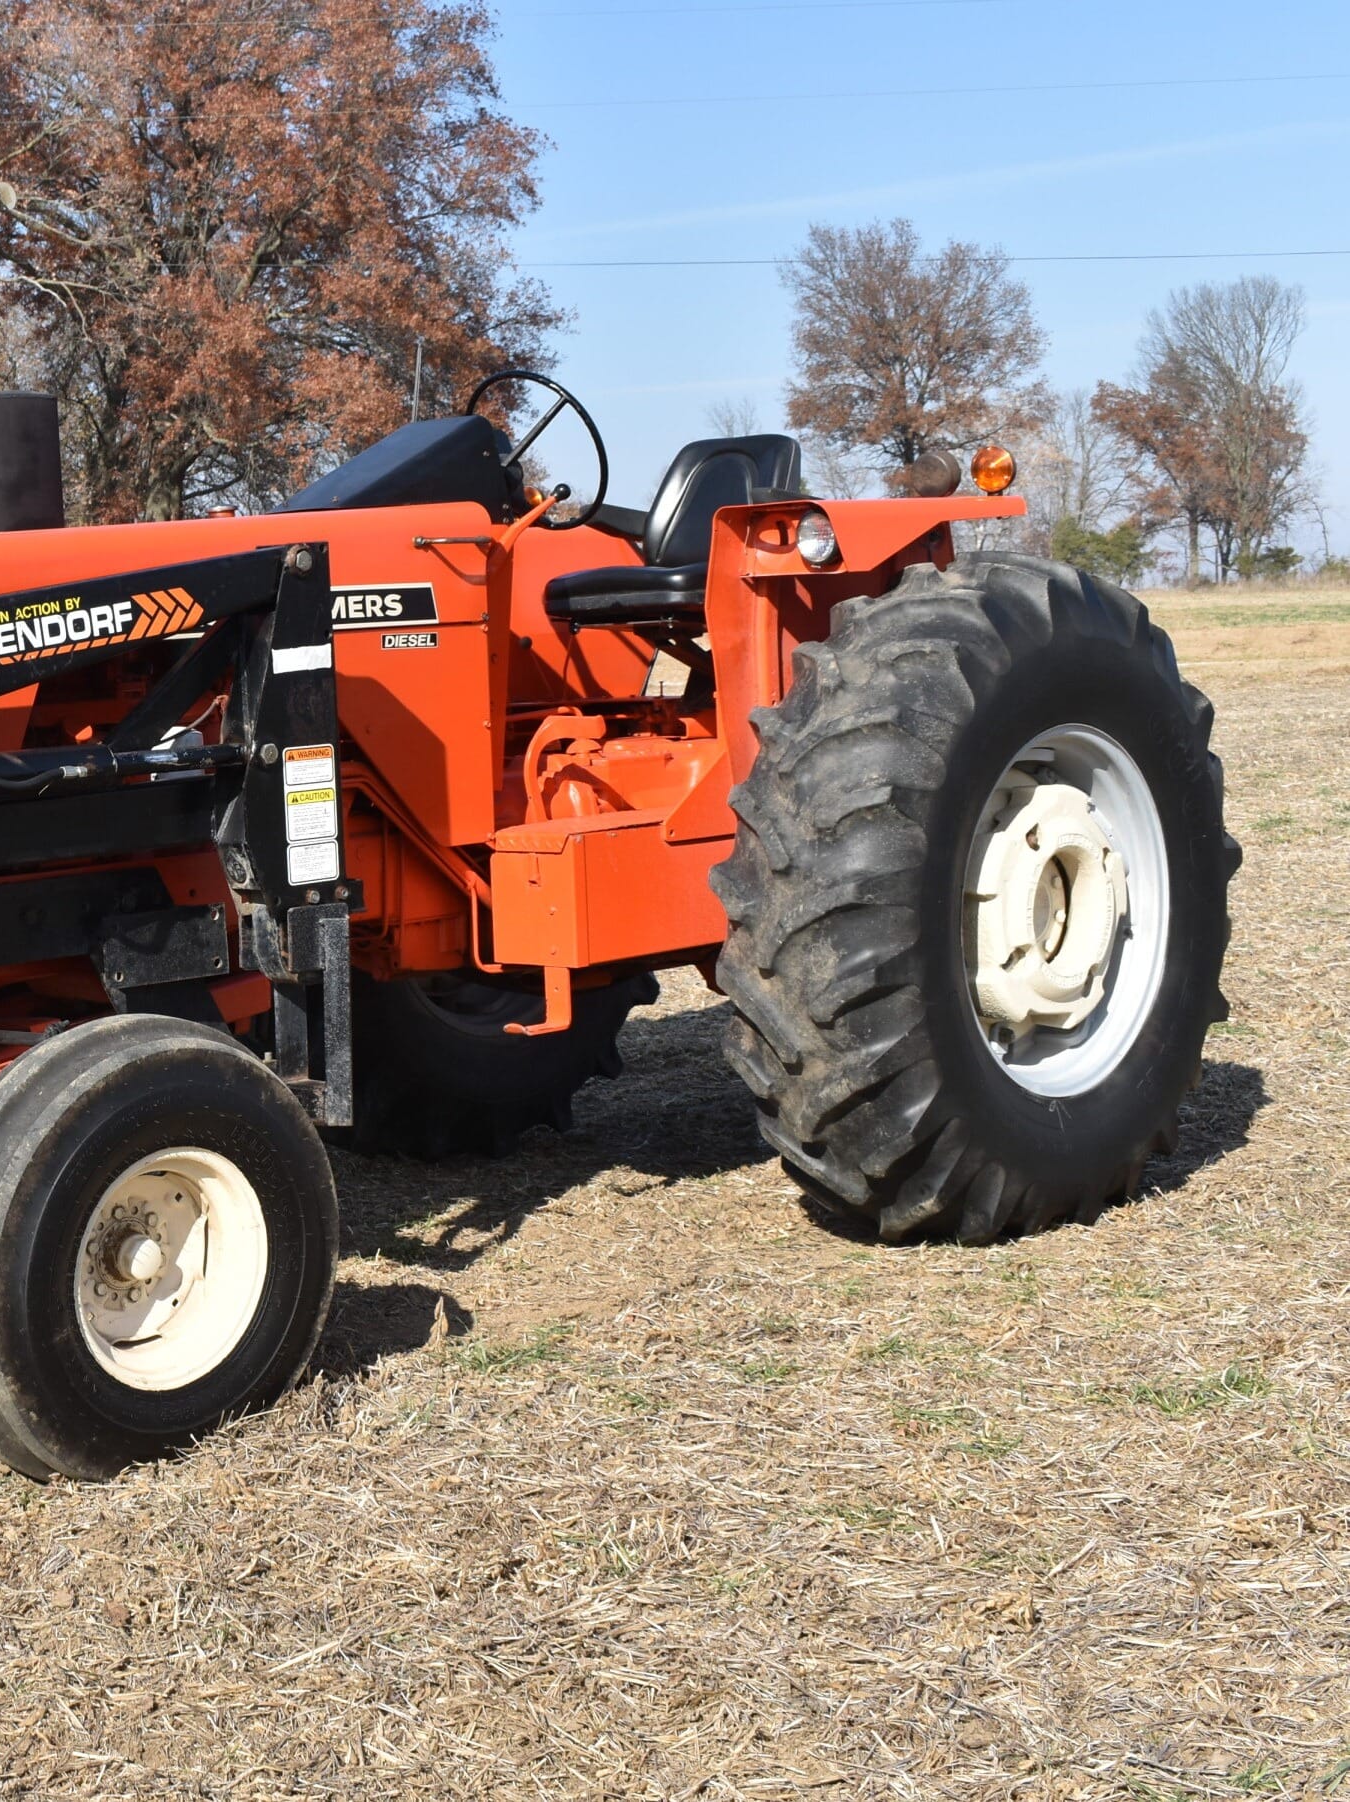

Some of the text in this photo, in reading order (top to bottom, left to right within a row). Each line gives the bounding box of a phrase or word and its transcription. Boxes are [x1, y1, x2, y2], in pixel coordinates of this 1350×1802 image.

[15, 601, 60, 621] ACTION
[64, 597, 81, 611] BY
[384, 634, 435, 648] DIESEL
[297, 750, 330, 759] WARNING
[299, 791, 330, 802] CAUTION
